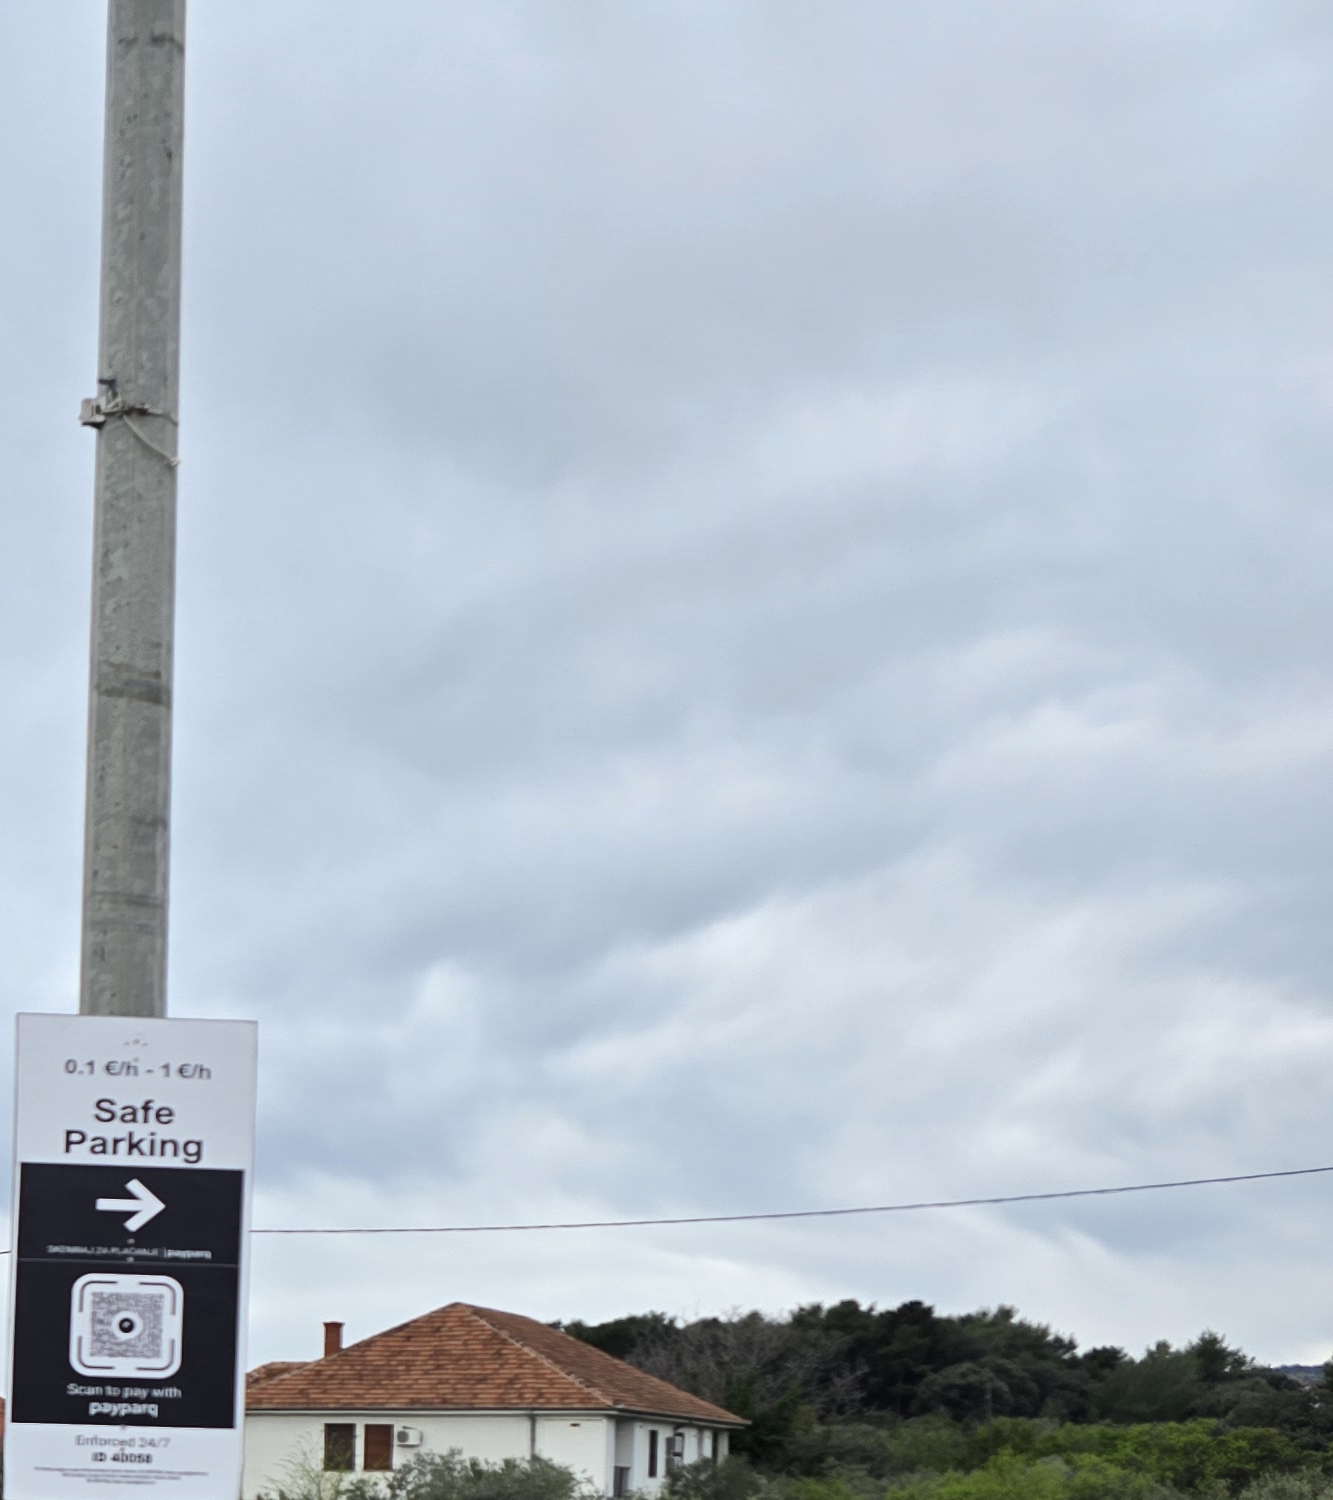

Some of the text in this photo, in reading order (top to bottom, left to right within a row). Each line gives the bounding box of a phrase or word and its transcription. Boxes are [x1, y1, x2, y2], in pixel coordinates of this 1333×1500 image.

[64, 1059, 95, 1075] 0.1
[105, 1060, 139, 1077] €/h
[161, 1062, 171, 1078] 1
[177, 1063, 212, 1080] €/h
[94, 1098, 175, 1125] Safe
[64, 1129, 204, 1165] Parking
[66, 1383, 182, 1400] Scan to pay with
[88, 1401, 159, 1418] payparq
[74, 1435, 171, 1449] Enforced 24/7
